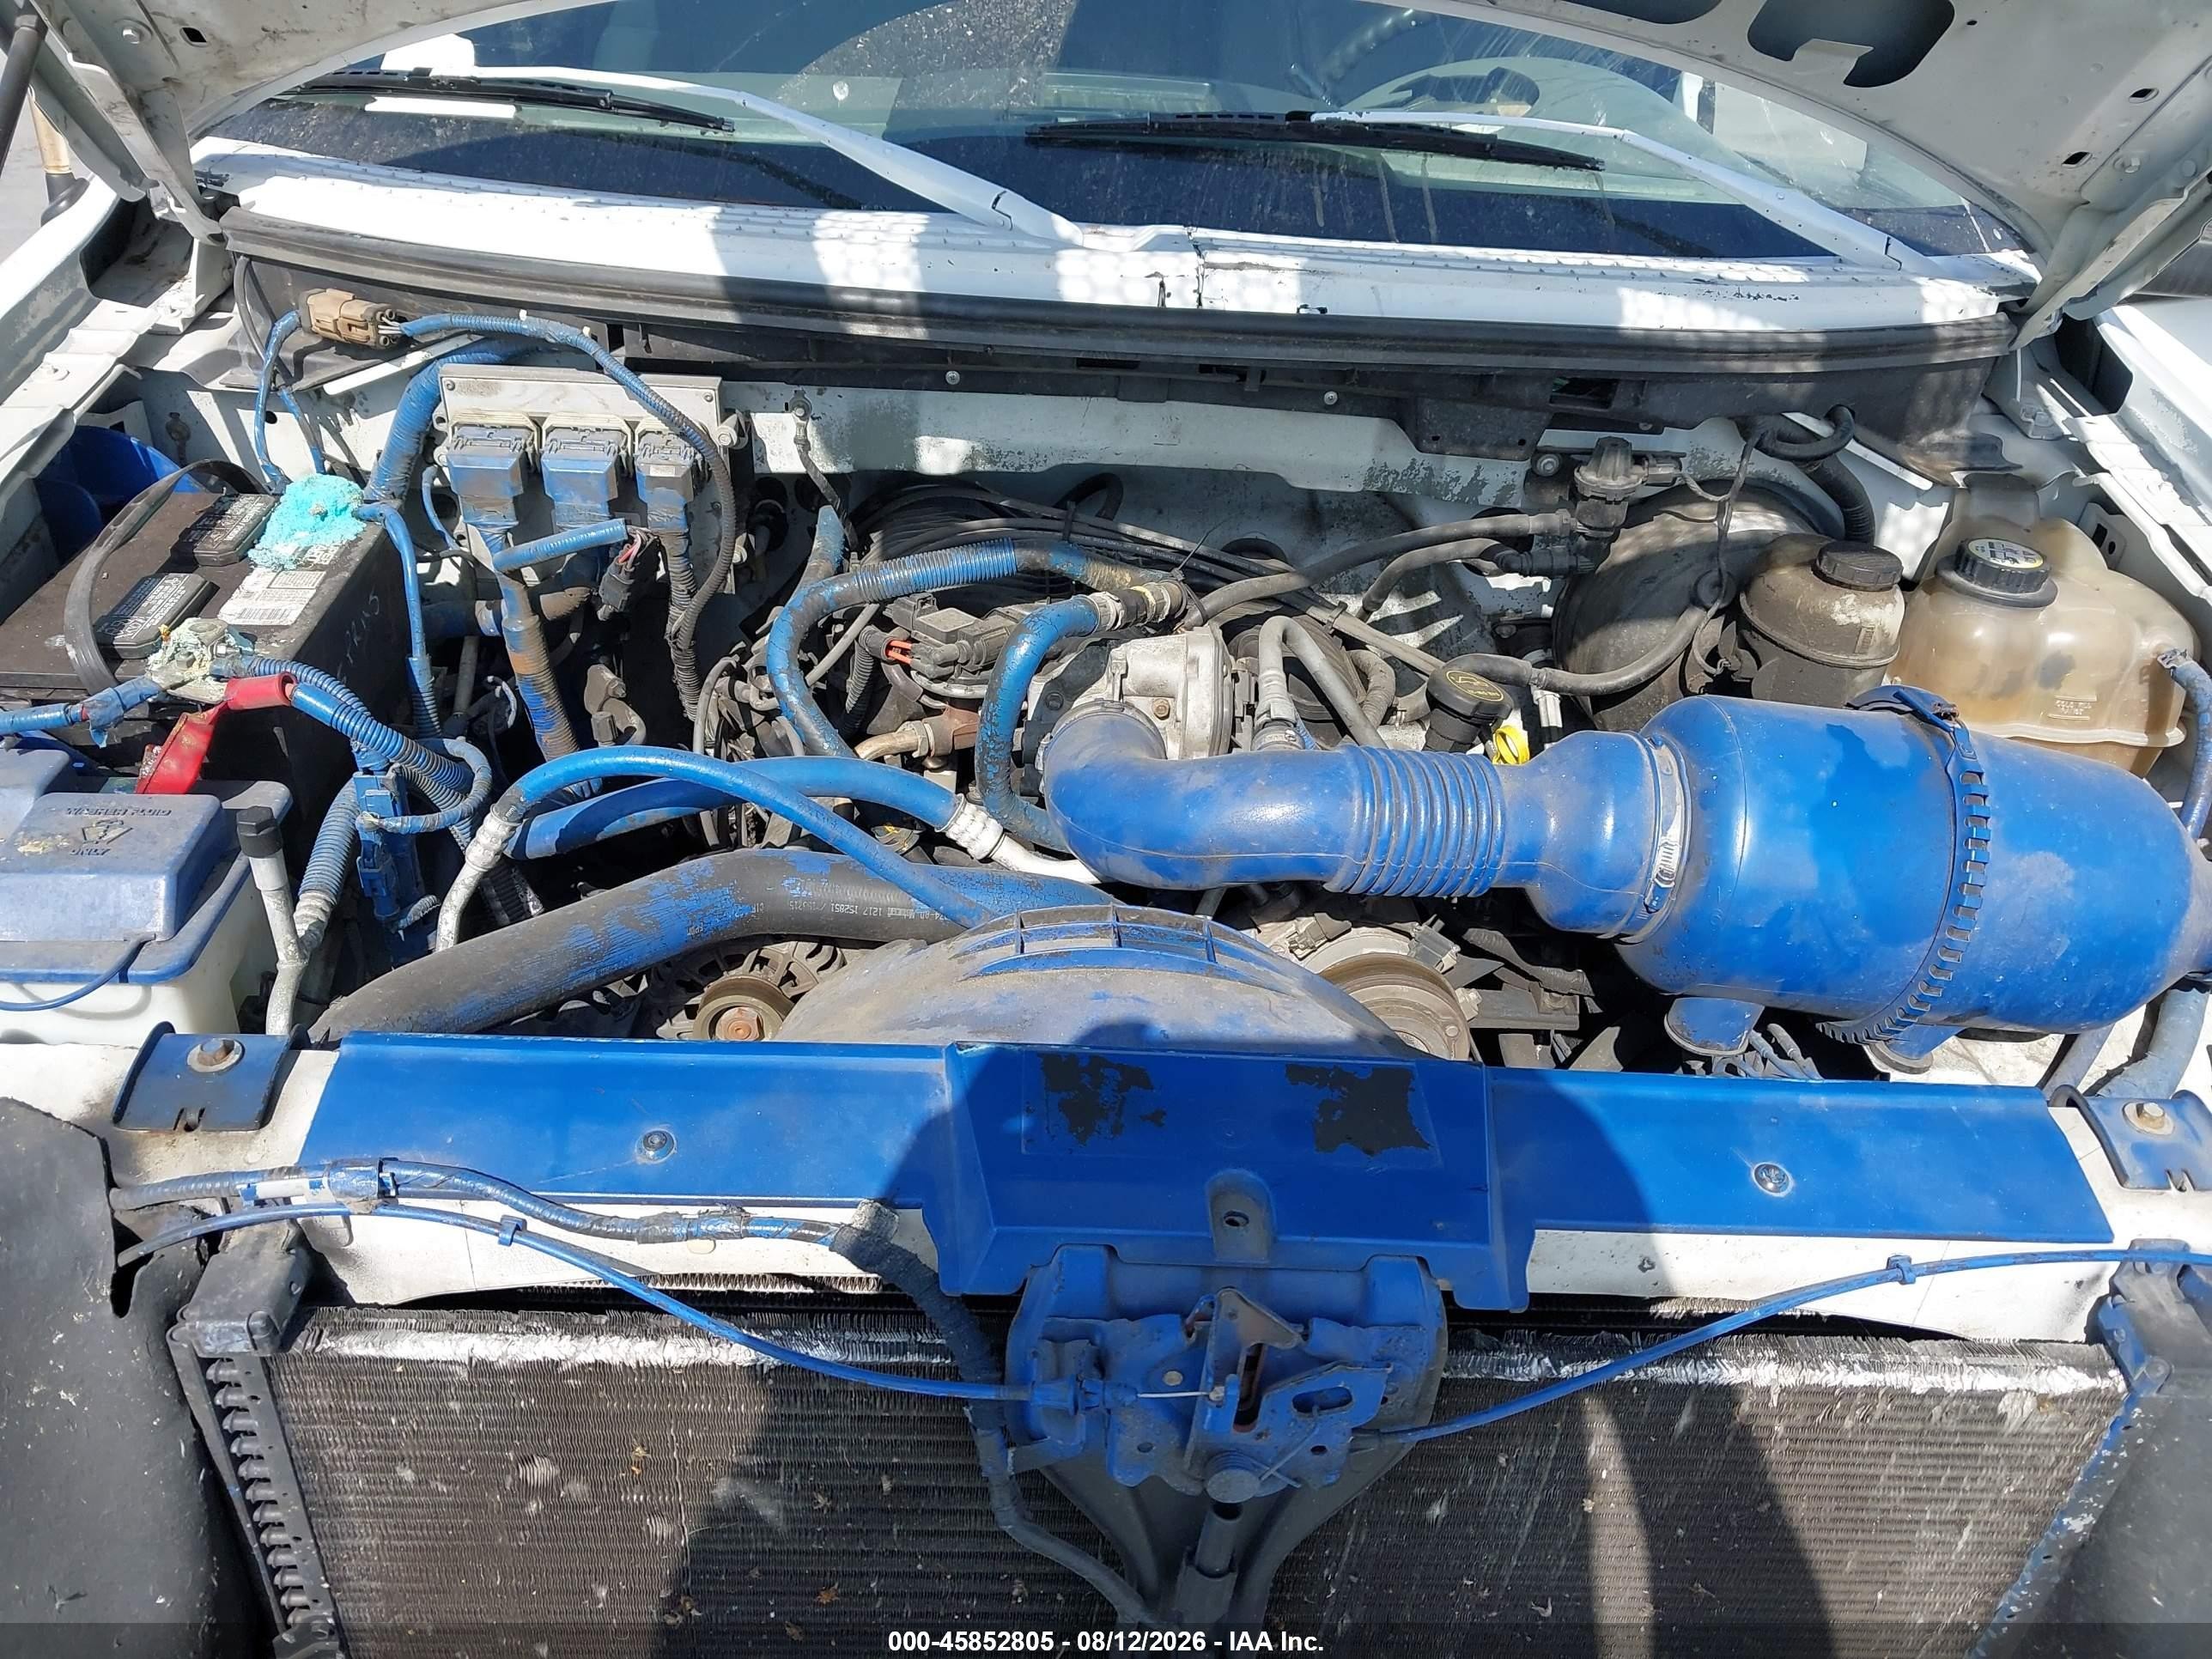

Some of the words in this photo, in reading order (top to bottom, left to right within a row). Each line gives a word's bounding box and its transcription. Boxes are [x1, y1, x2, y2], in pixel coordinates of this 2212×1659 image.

[66, 807, 129, 817] WASHER
[131, 808, 172, 817] FLUID
[70, 848, 111, 856] ONLY
[862, 906, 882, 916] 1217
